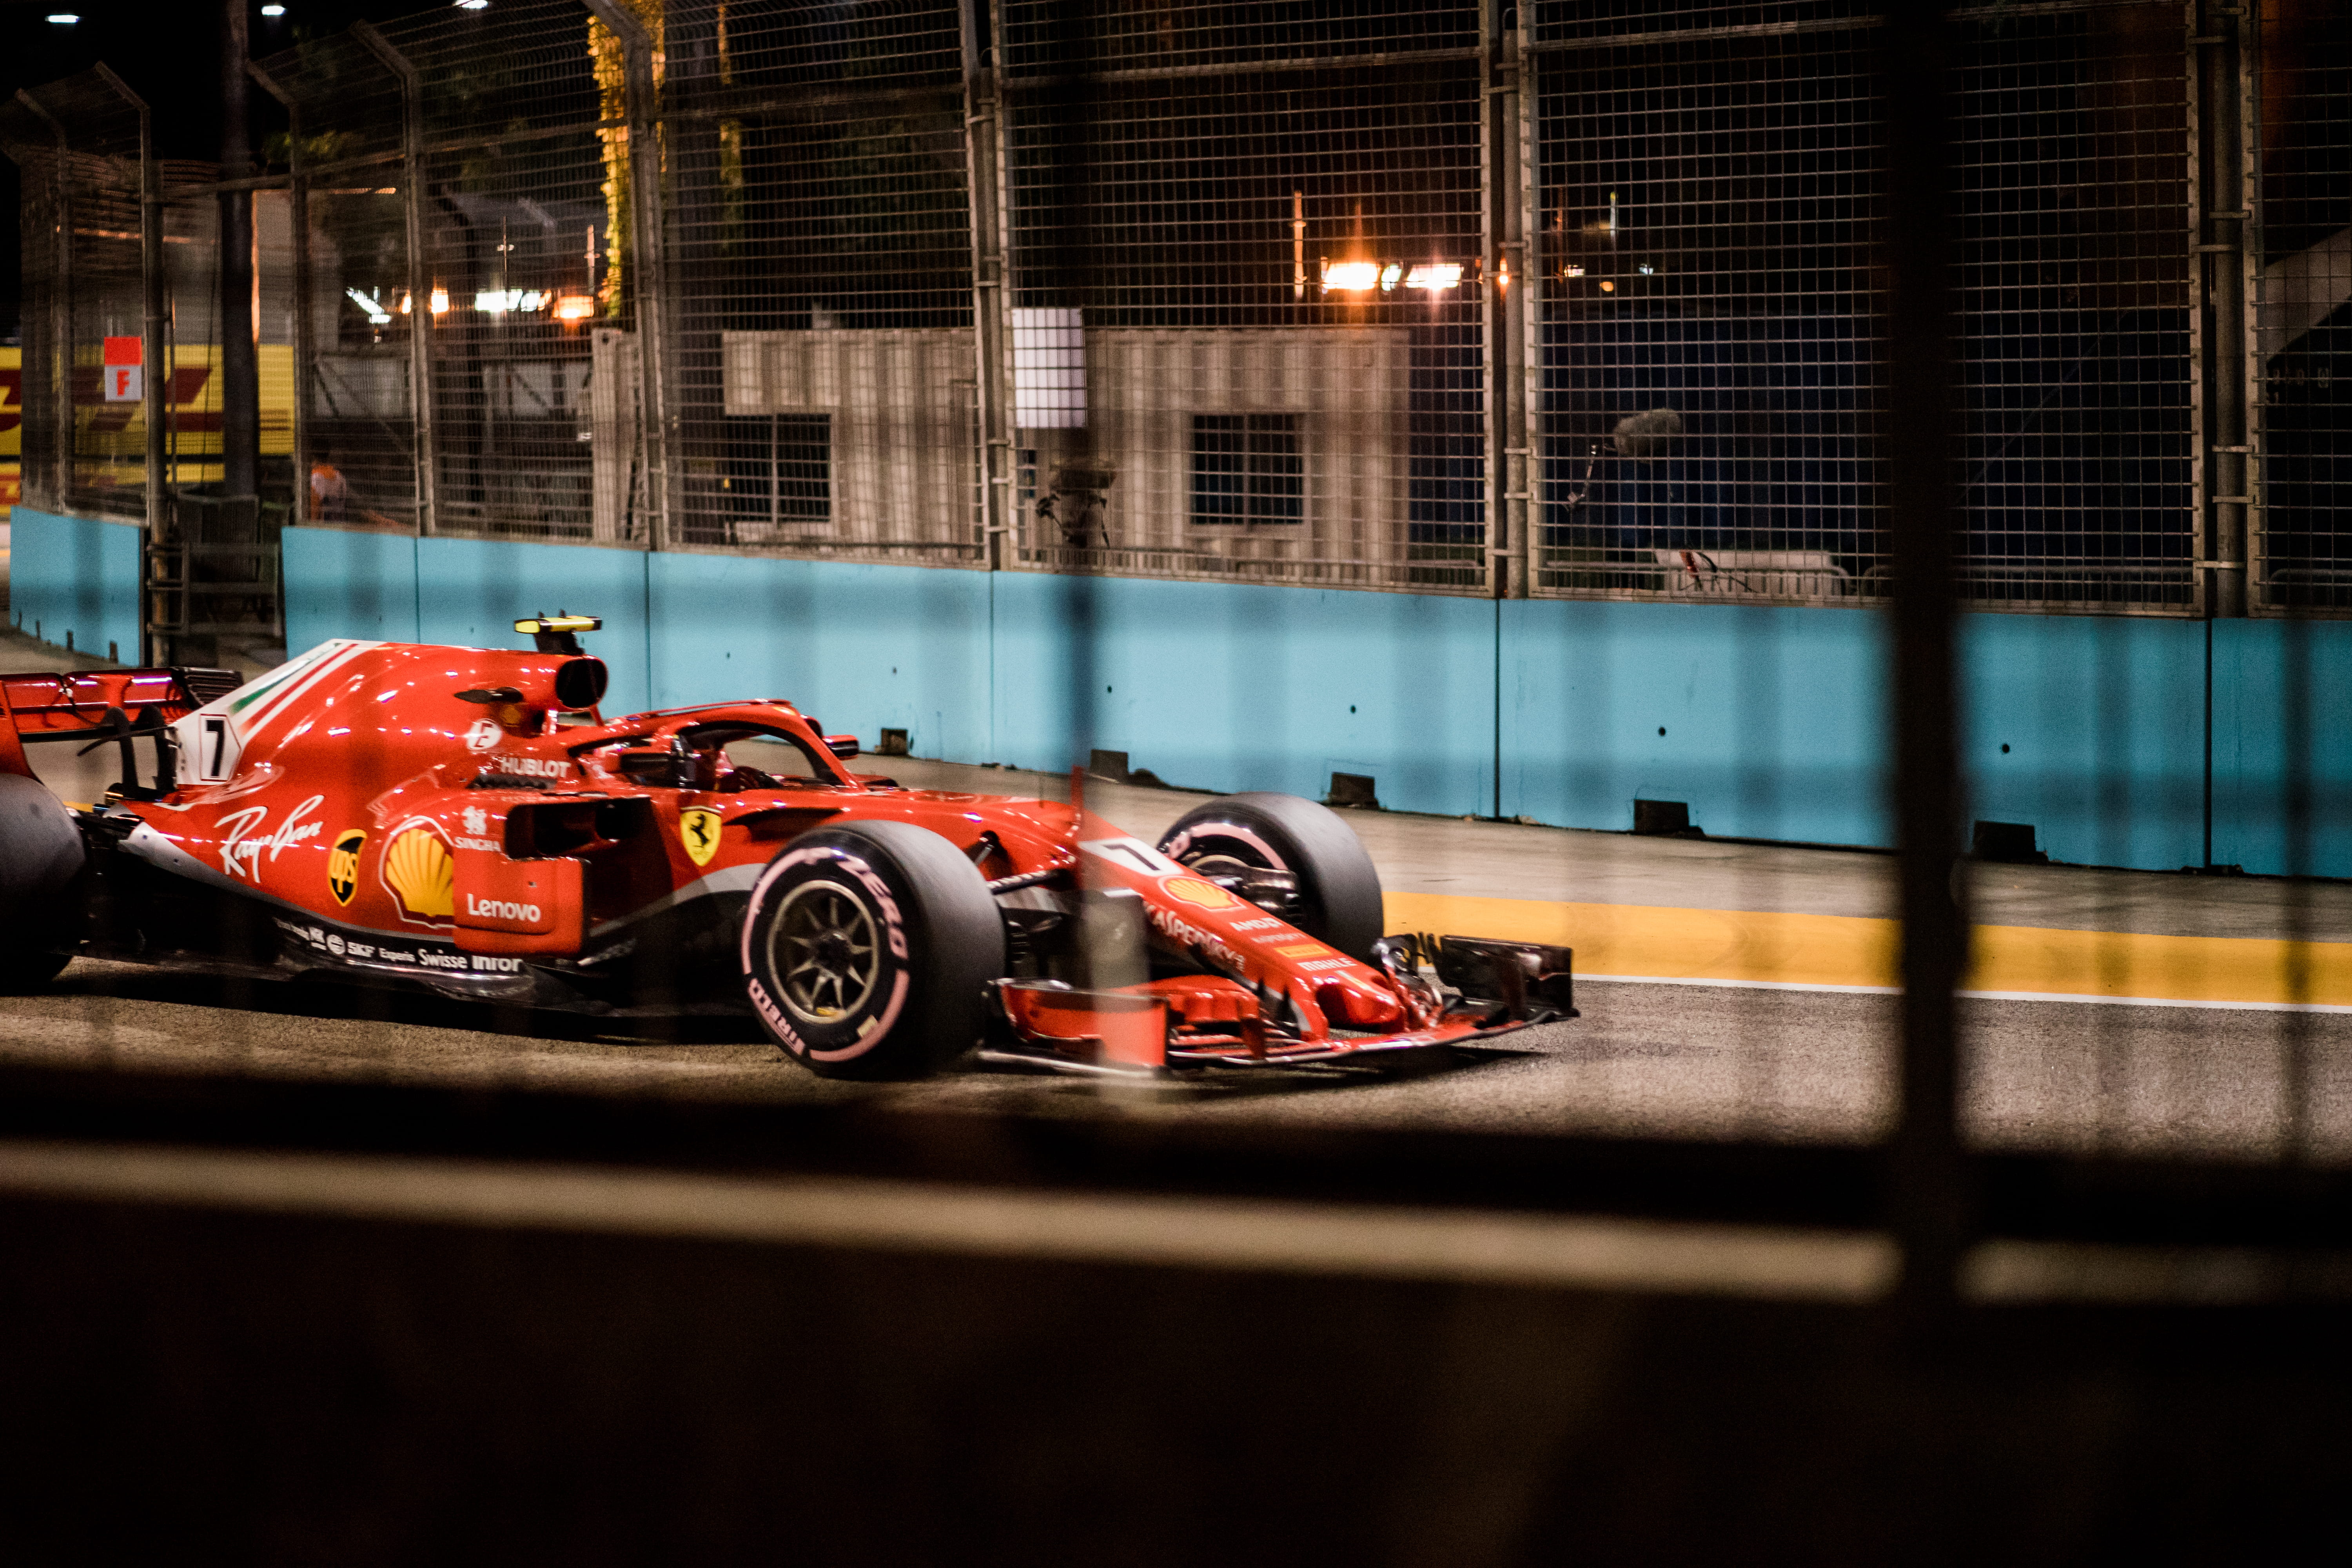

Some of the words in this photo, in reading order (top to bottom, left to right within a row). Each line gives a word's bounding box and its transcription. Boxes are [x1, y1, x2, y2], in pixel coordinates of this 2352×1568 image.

[117, 370, 130, 396] F
[205, 719, 225, 778] 7
[500, 757, 571, 777] HUBLOT
[467, 893, 541, 922] Lenovo
[417, 948, 468, 969] Swisse
[1297, 958, 1359, 971] MAHLE
